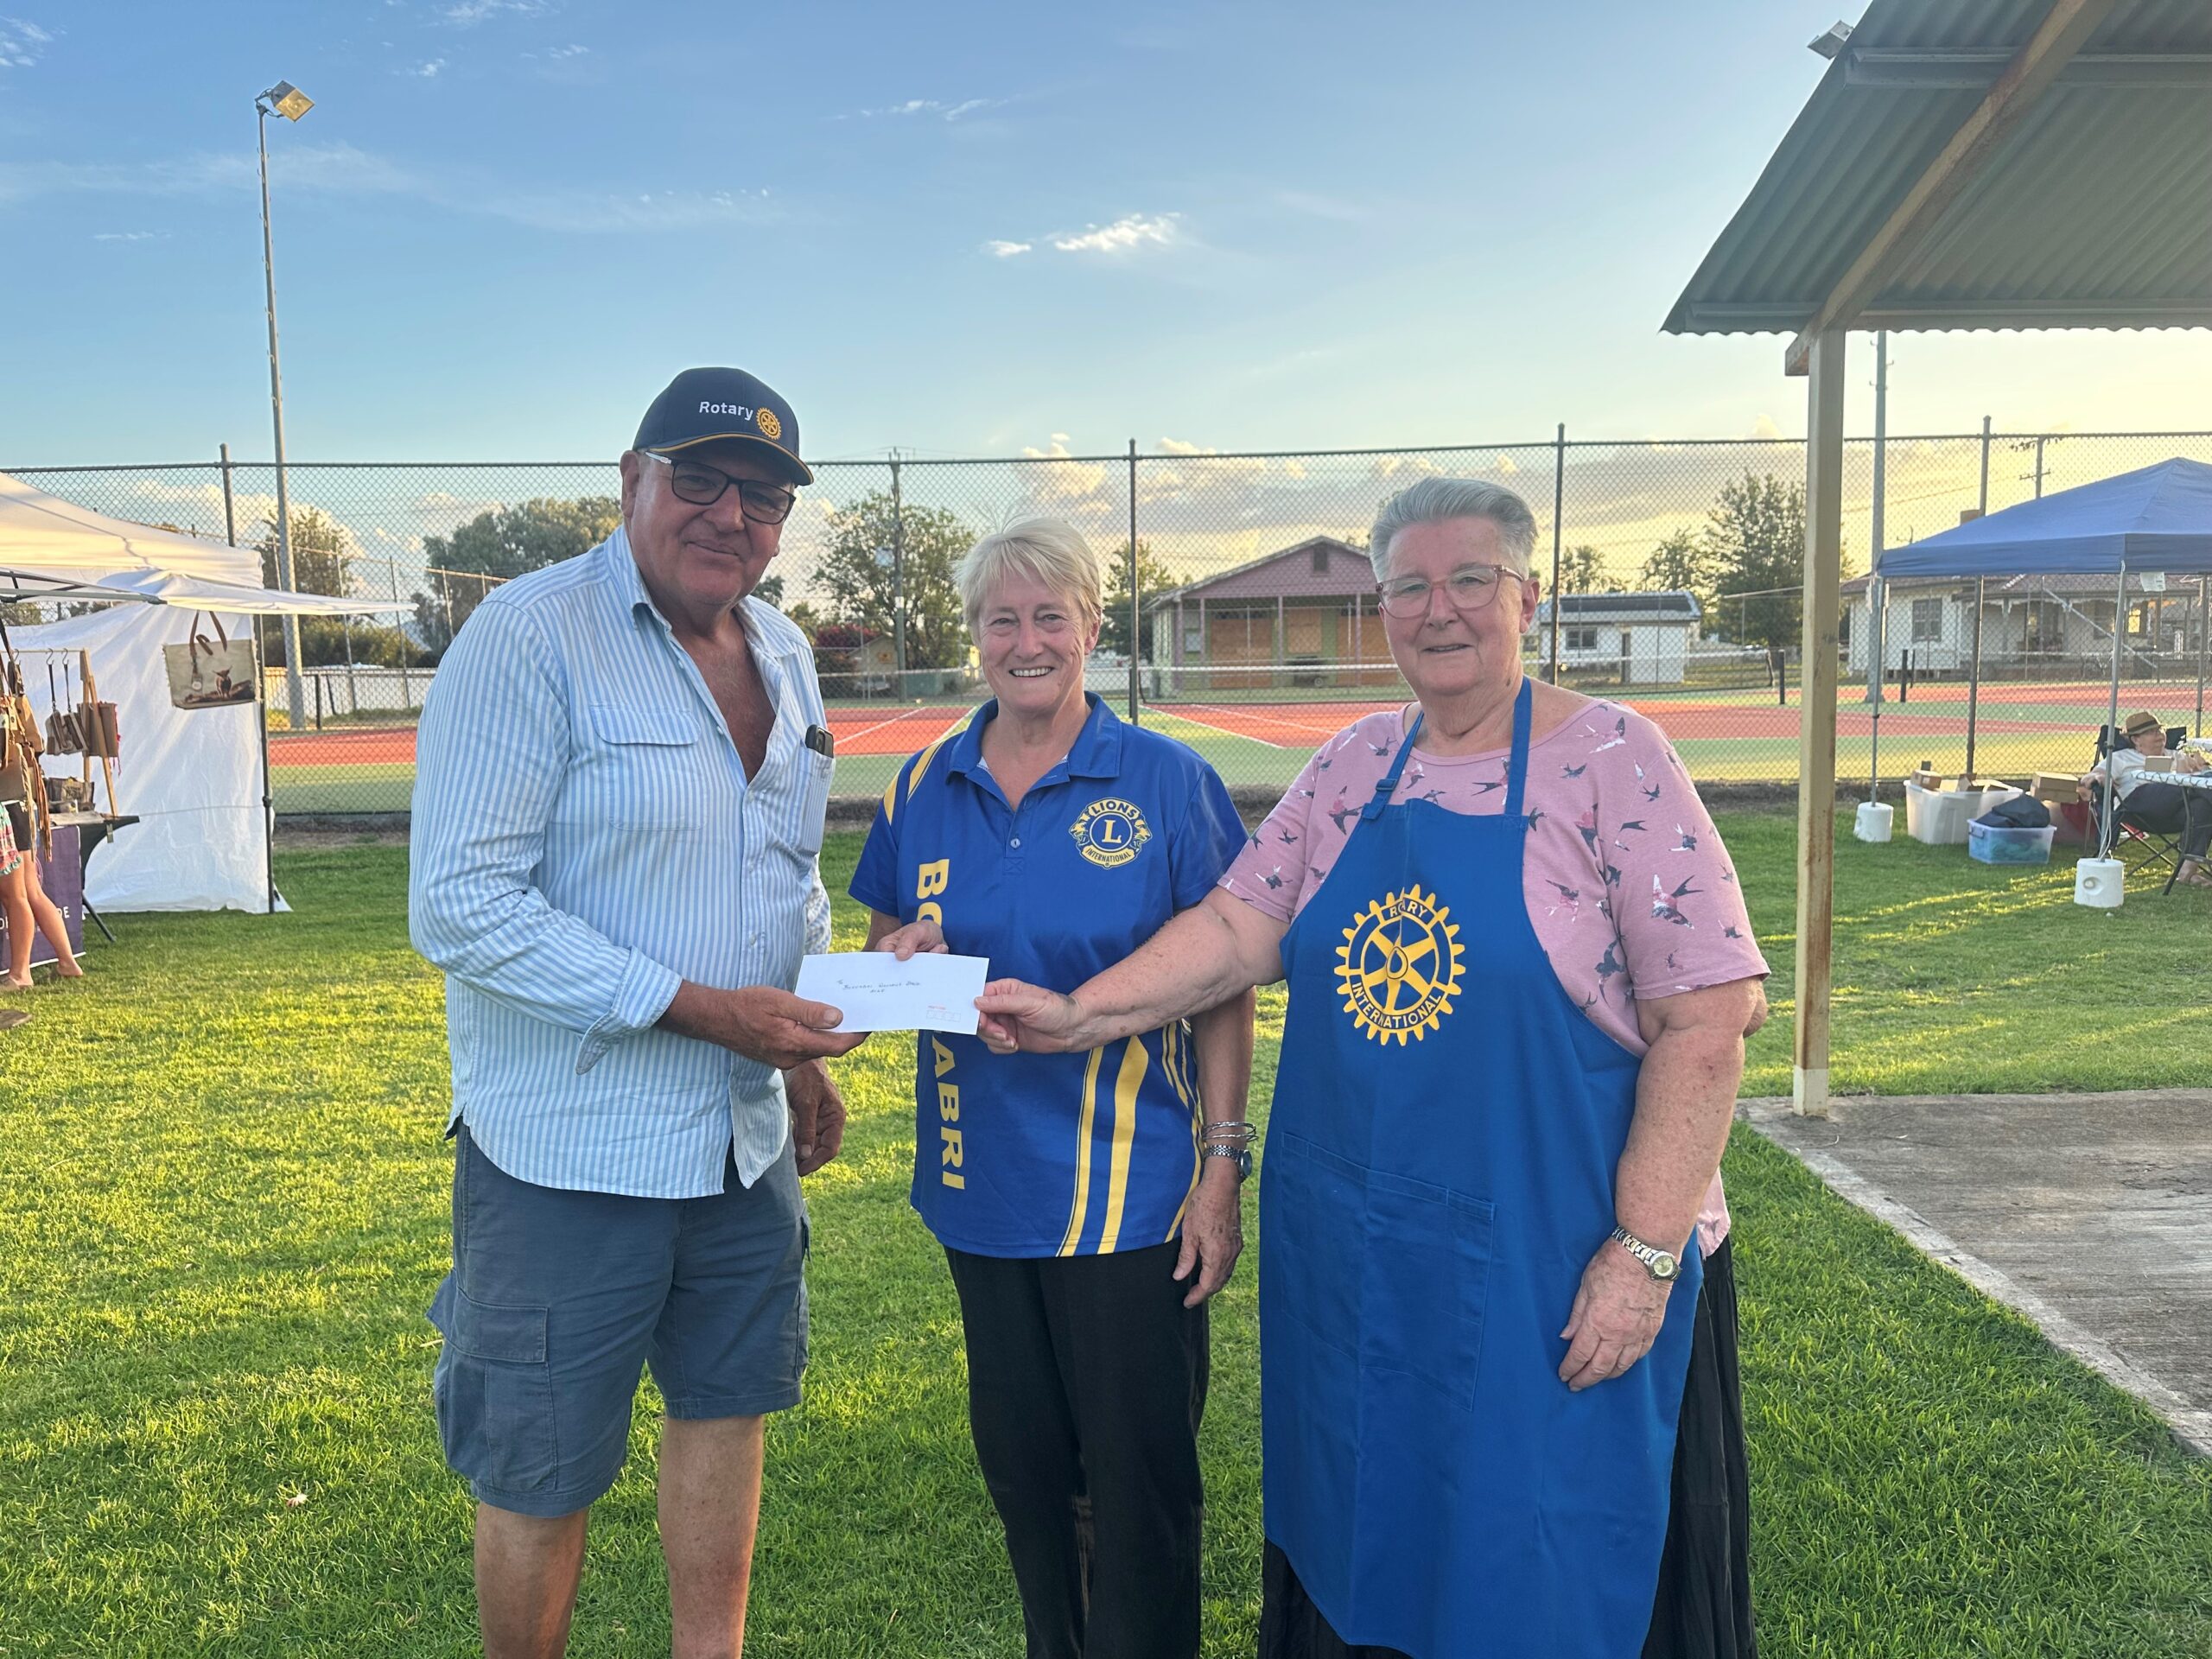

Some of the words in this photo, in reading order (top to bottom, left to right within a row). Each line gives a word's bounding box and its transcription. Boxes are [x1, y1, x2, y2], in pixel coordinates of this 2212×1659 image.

[699, 401, 753, 421] Rotary
[1091, 800, 1137, 818] LIONS
[1102, 819, 1122, 843] L
[1085, 848, 1131, 862] INTERNATIONAL
[1352, 982, 1441, 1028] INTERNATIONAL
